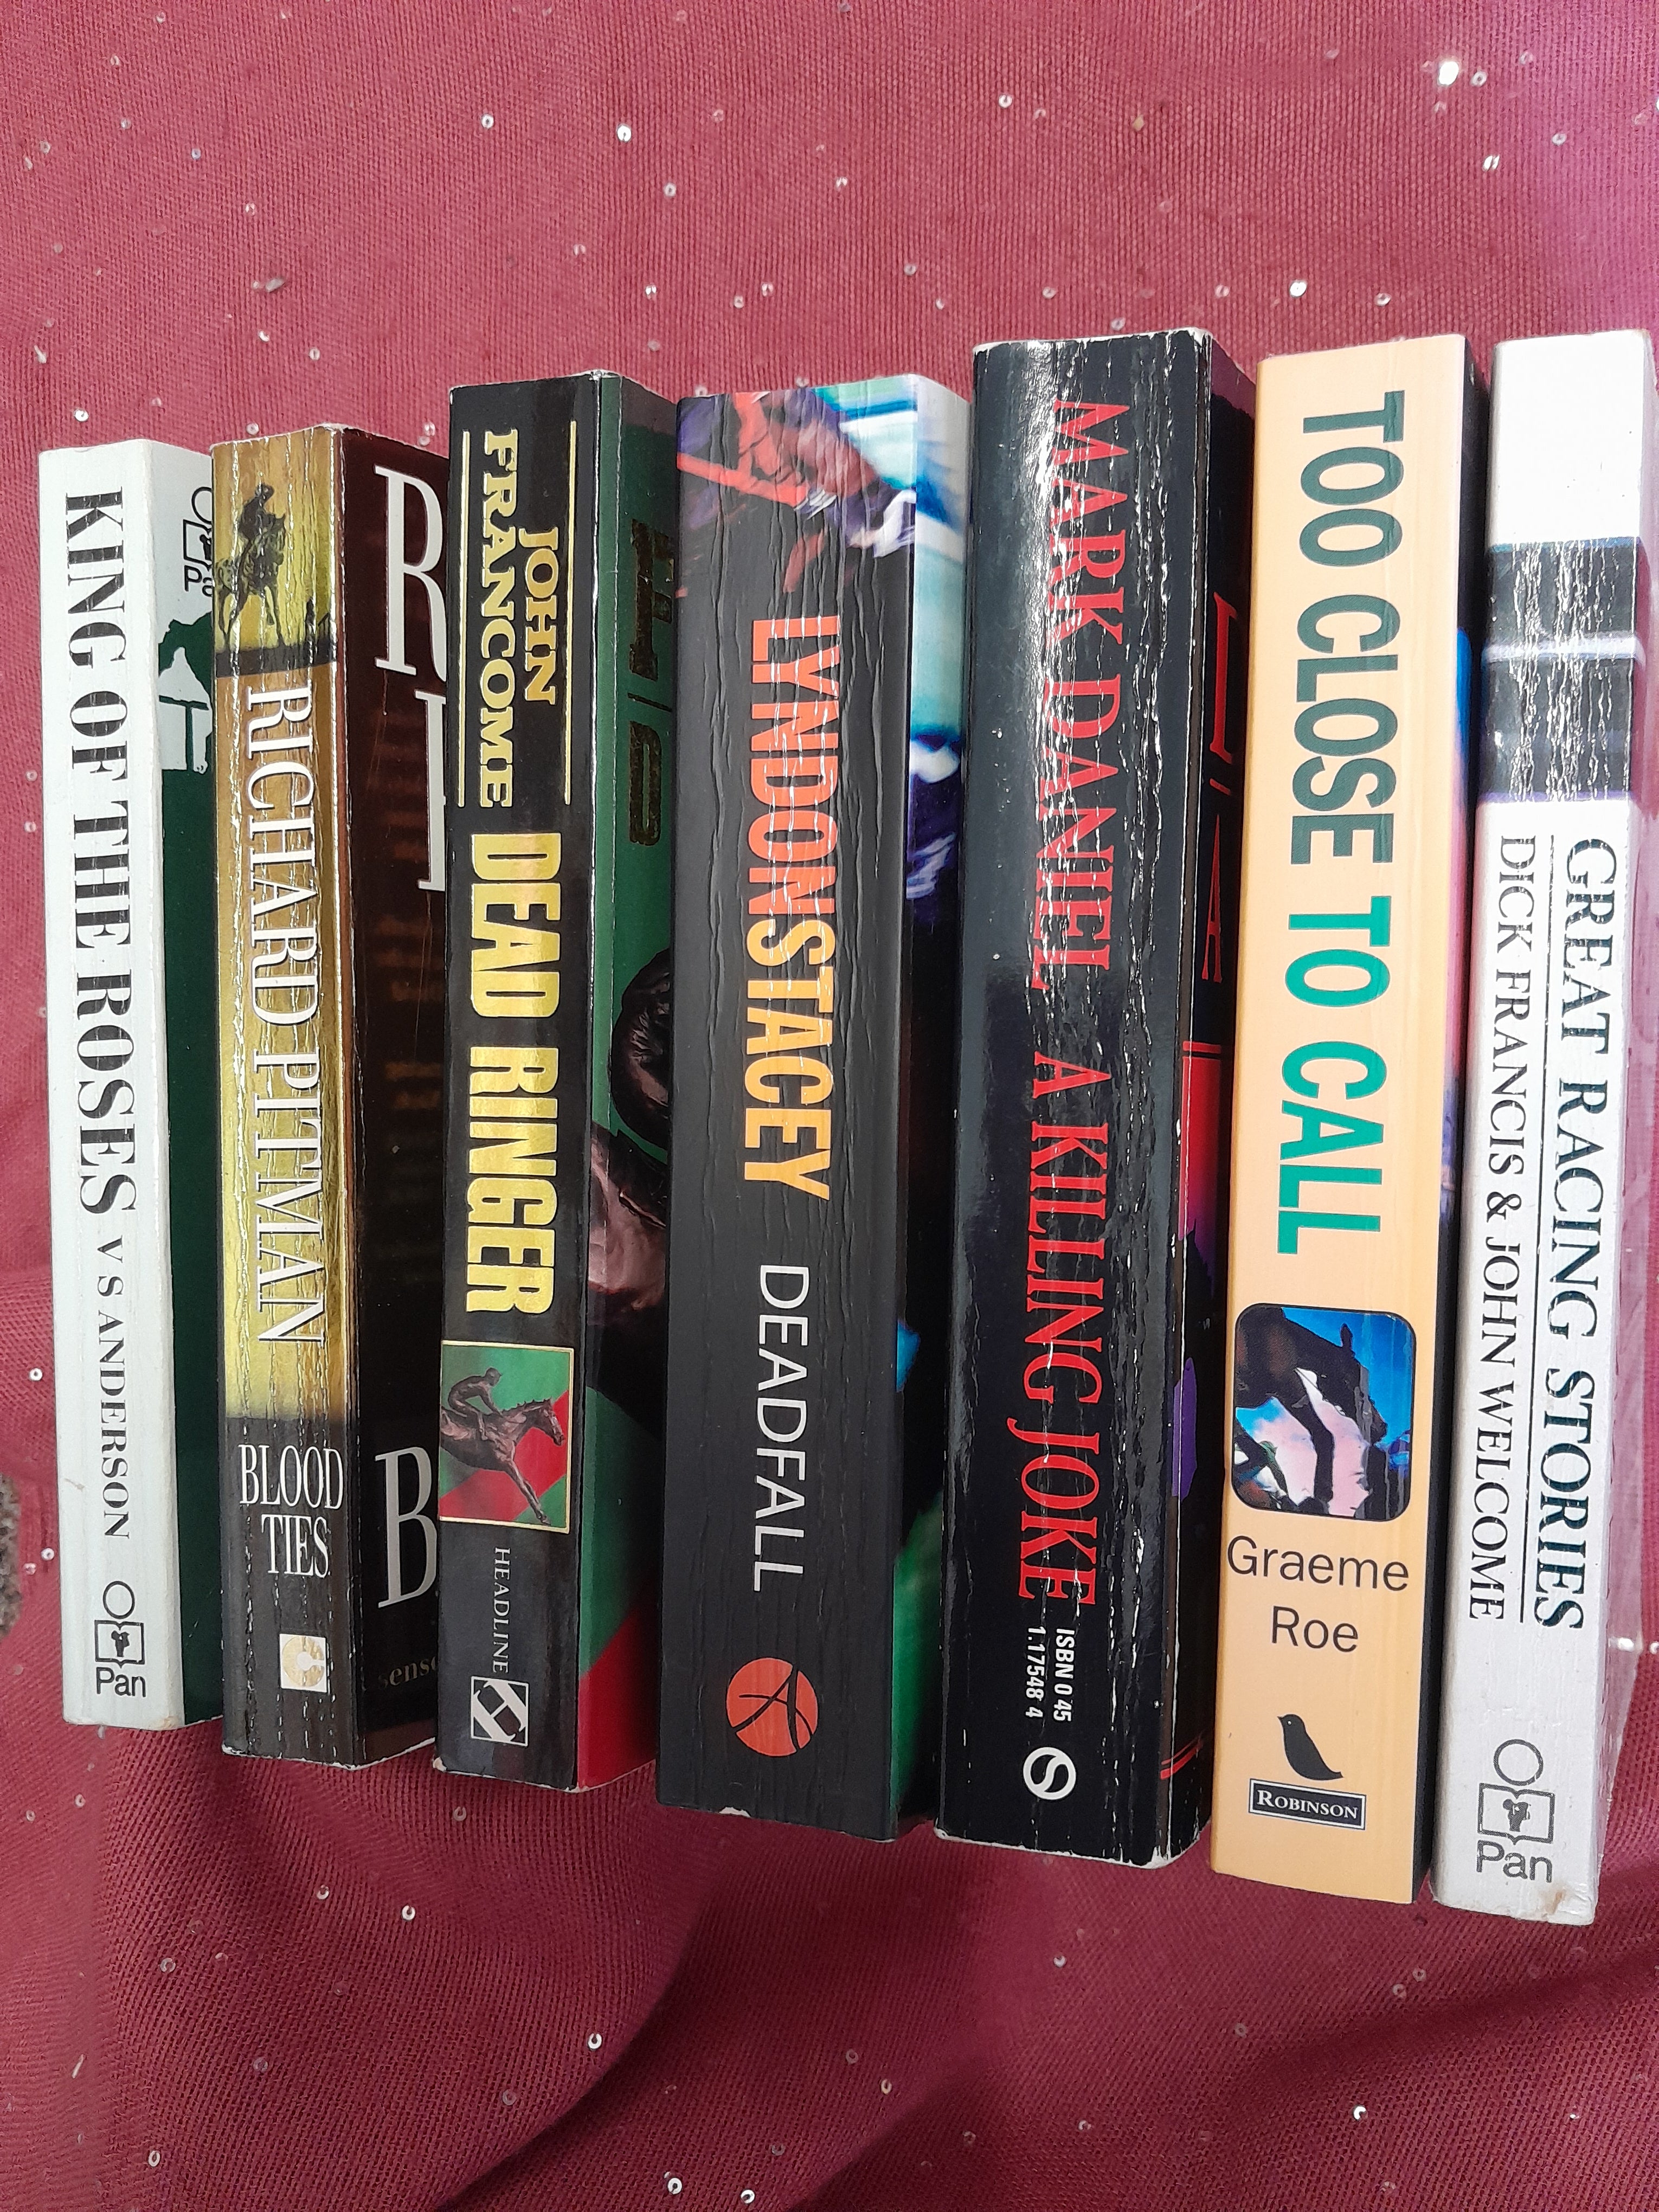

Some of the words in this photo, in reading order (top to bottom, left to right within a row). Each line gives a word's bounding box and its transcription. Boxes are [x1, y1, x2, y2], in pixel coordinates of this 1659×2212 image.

[1046, 398, 1130, 647] MARK
[1299, 390, 1405, 567] TOO
[66, 486, 126, 669] KING
[184, 565, 213, 597] Pa
[479, 429, 518, 808] FRANCOME
[519, 526, 558, 705] JOHN
[69, 691, 128, 781] OF
[1291, 594, 1400, 865] CLOSE
[74, 800, 131, 949] THE
[246, 679, 319, 1025] RICHARD
[1031, 674, 1121, 991] DANIEL
[1497, 835, 1535, 953] DICK
[471, 833, 561, 1018] DEAD
[1285, 896, 1391, 1007] TO
[1561, 838, 1617, 1055] GREAT
[77, 969, 136, 1214] ROSES
[1032, 1051, 1111, 1098] A
[1277, 1041, 1388, 1255] CALL
[1488, 969, 1531, 1175] FRANCIS
[253, 1047, 325, 1347] PITMAN
[466, 1046, 558, 1314] RINGER
[1023, 1121, 1109, 1404] KILLING
[1487, 1191, 1522, 1223] &
[1548, 1078, 1608, 1339] RACING
[97, 1276, 124, 1297] S
[1480, 1237, 1520, 1367] JOHN
[98, 1310, 130, 1539] ANDERSON
[238, 1444, 343, 1509] BLOOD
[754, 1265, 809, 1592] DEADFALL
[1007, 1417, 1099, 1605] JOKE
[1469, 1381, 1514, 1620] WELCOME
[1534, 1368, 1595, 1629] STORIES
[261, 1514, 329, 1578] TIES
[493, 1547, 511, 1674] HEADLINE
[1227, 1535, 1409, 1591] Graeme
[1271, 1605, 1359, 1652] Roe
[95, 1667, 146, 1699] Pan
[1026, 1706, 1043, 1718] 4
[1053, 1699, 1072, 1722] 45
[1055, 1628, 1075, 1680] ISBN
[1257, 1790, 1358, 1820] ROBINSON
[1477, 1840, 1553, 1883] Pan
